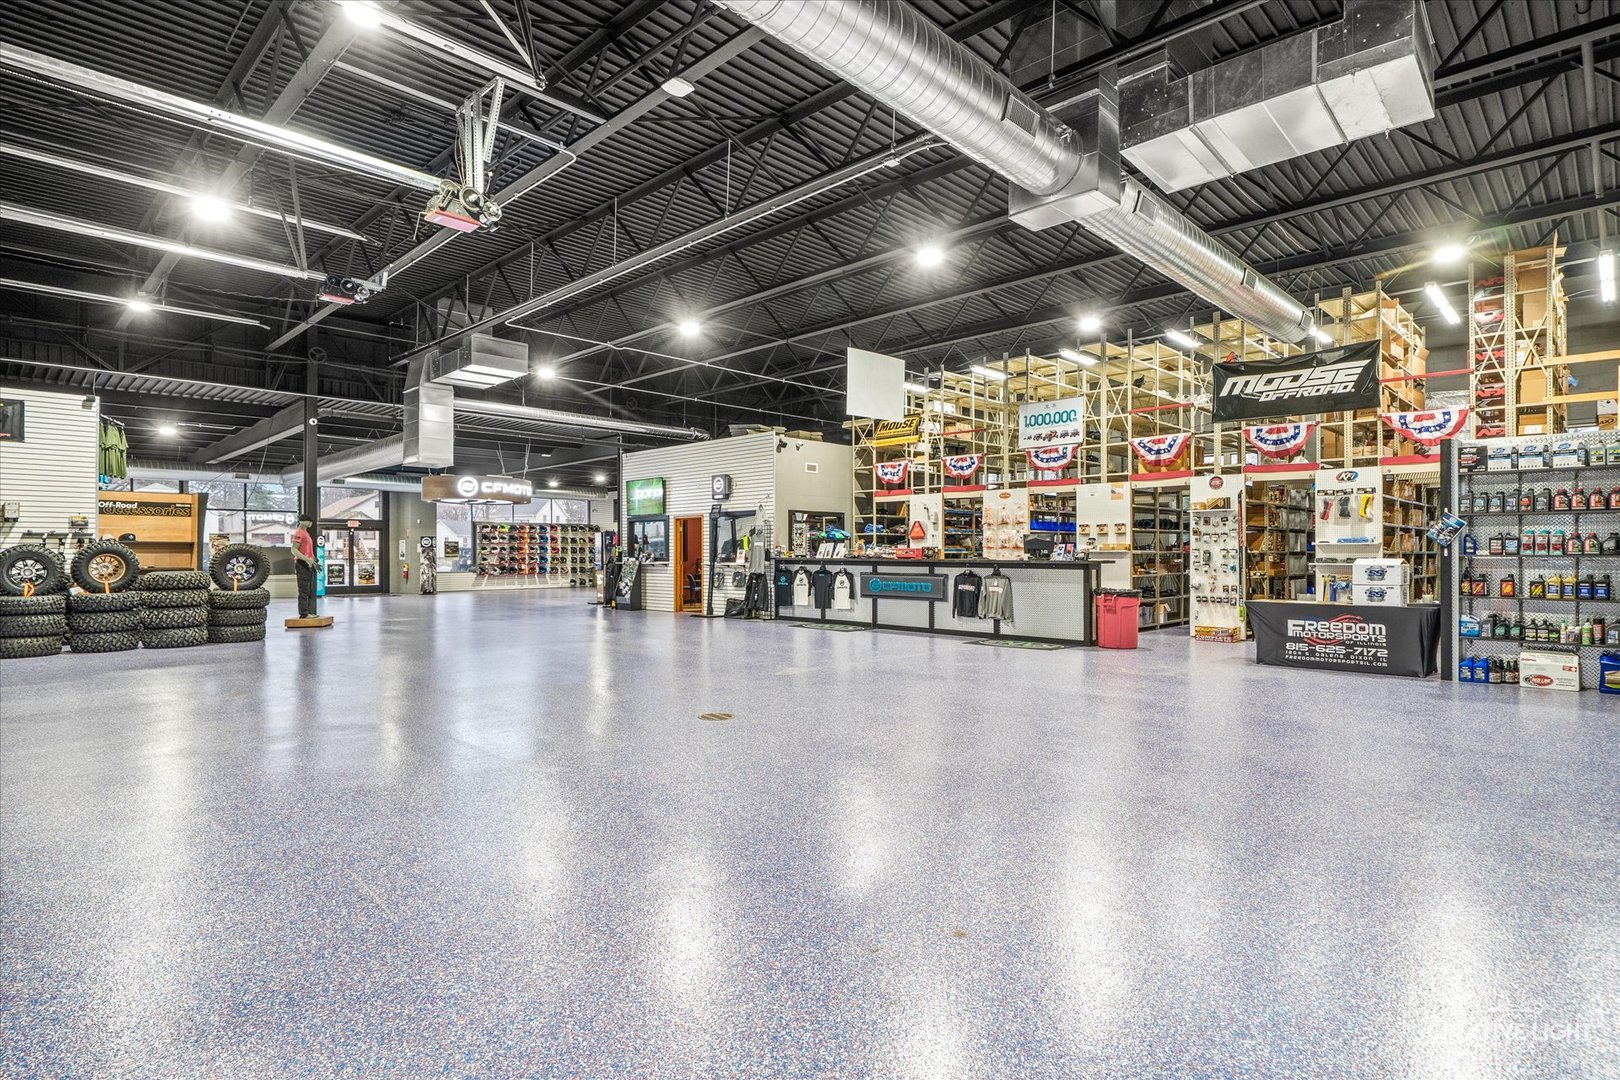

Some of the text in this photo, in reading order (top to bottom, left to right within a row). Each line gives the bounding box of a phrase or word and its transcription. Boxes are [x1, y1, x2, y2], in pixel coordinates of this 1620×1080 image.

[1219, 359, 1372, 397] MOOSE
[98, 501, 138, 509] Off-Road
[103, 505, 191, 516] accessories
[1293, 631, 1387, 643] MOTORSPORTS
[1285, 642, 1388, 657] 815-625-7172
